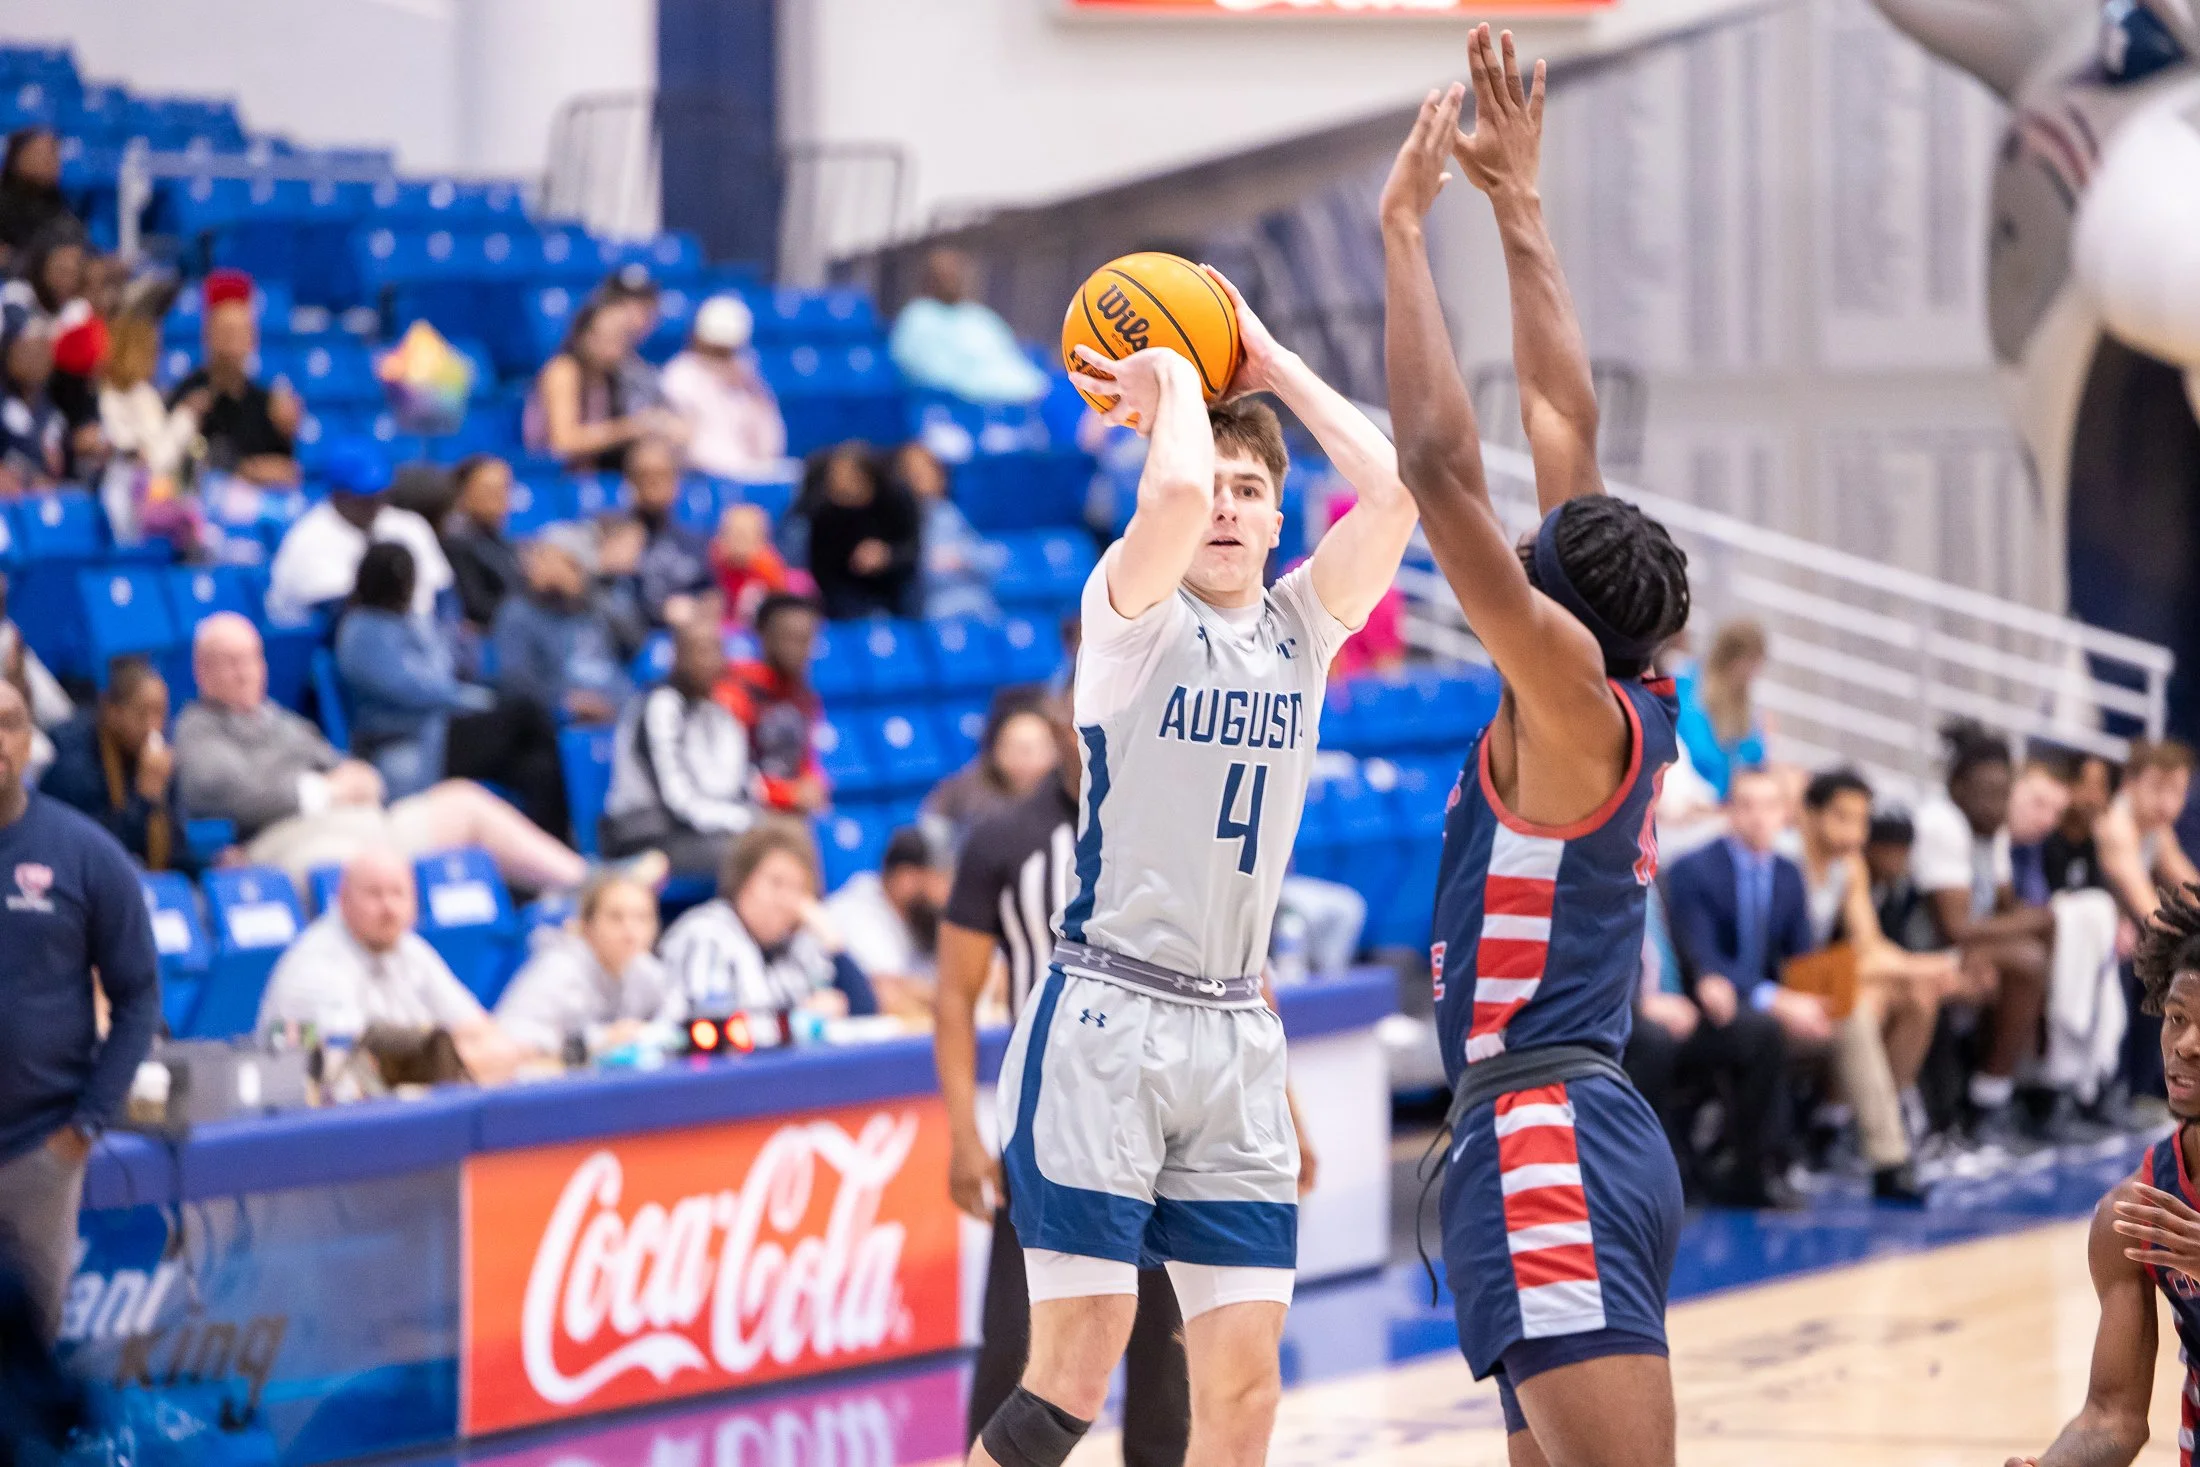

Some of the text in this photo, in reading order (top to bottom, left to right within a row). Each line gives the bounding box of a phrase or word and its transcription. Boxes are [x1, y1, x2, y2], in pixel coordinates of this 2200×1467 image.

[1097, 283, 1150, 352] Wils
[1157, 683, 1304, 750] AUGUST
[1215, 761, 1270, 877] 4
[521, 1112, 920, 1405] Coca-Cola
